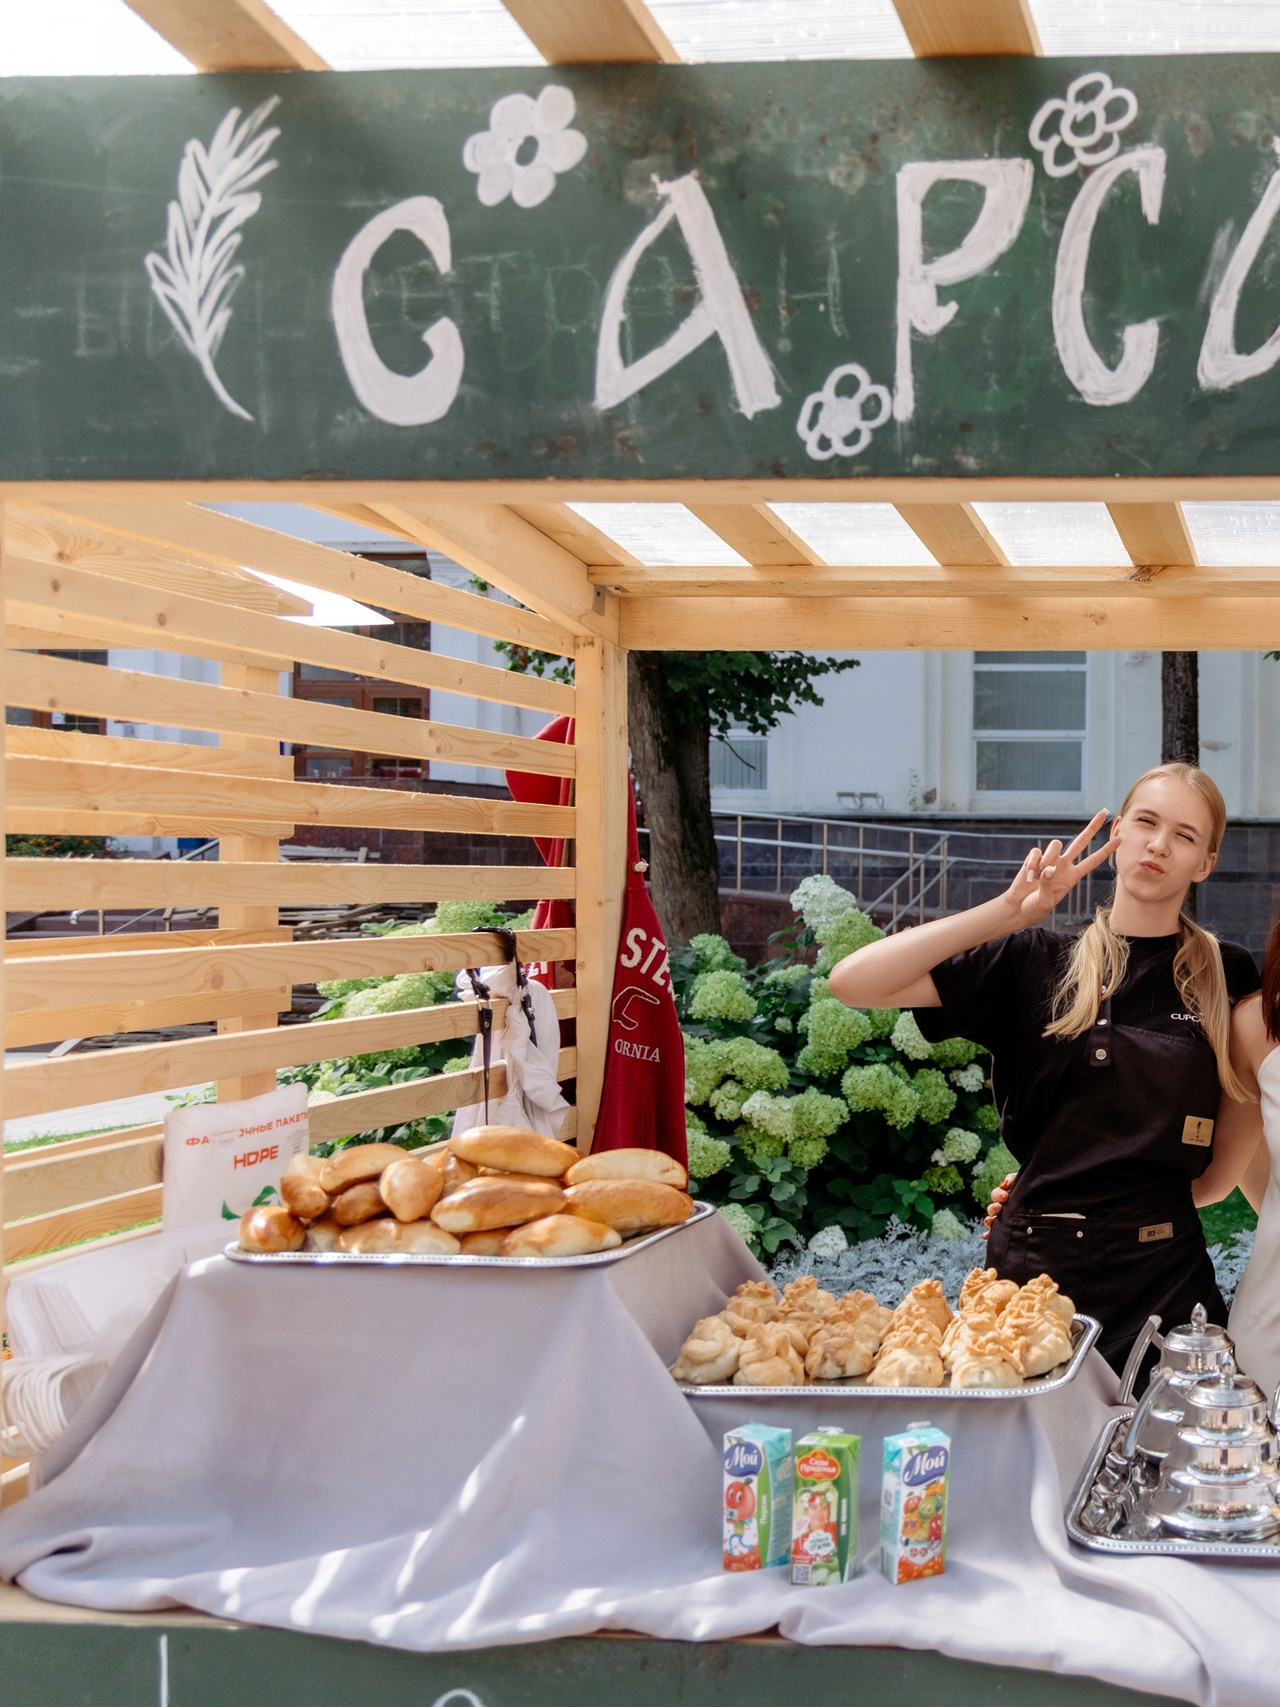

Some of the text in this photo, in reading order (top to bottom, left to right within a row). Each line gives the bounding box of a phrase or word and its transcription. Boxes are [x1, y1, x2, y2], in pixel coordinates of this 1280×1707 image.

[619, 927, 675, 1000] STE
[233, 1145, 280, 1170] HDPE
[725, 1445, 758, 1470] Мой
[903, 1451, 945, 1482] Мой
